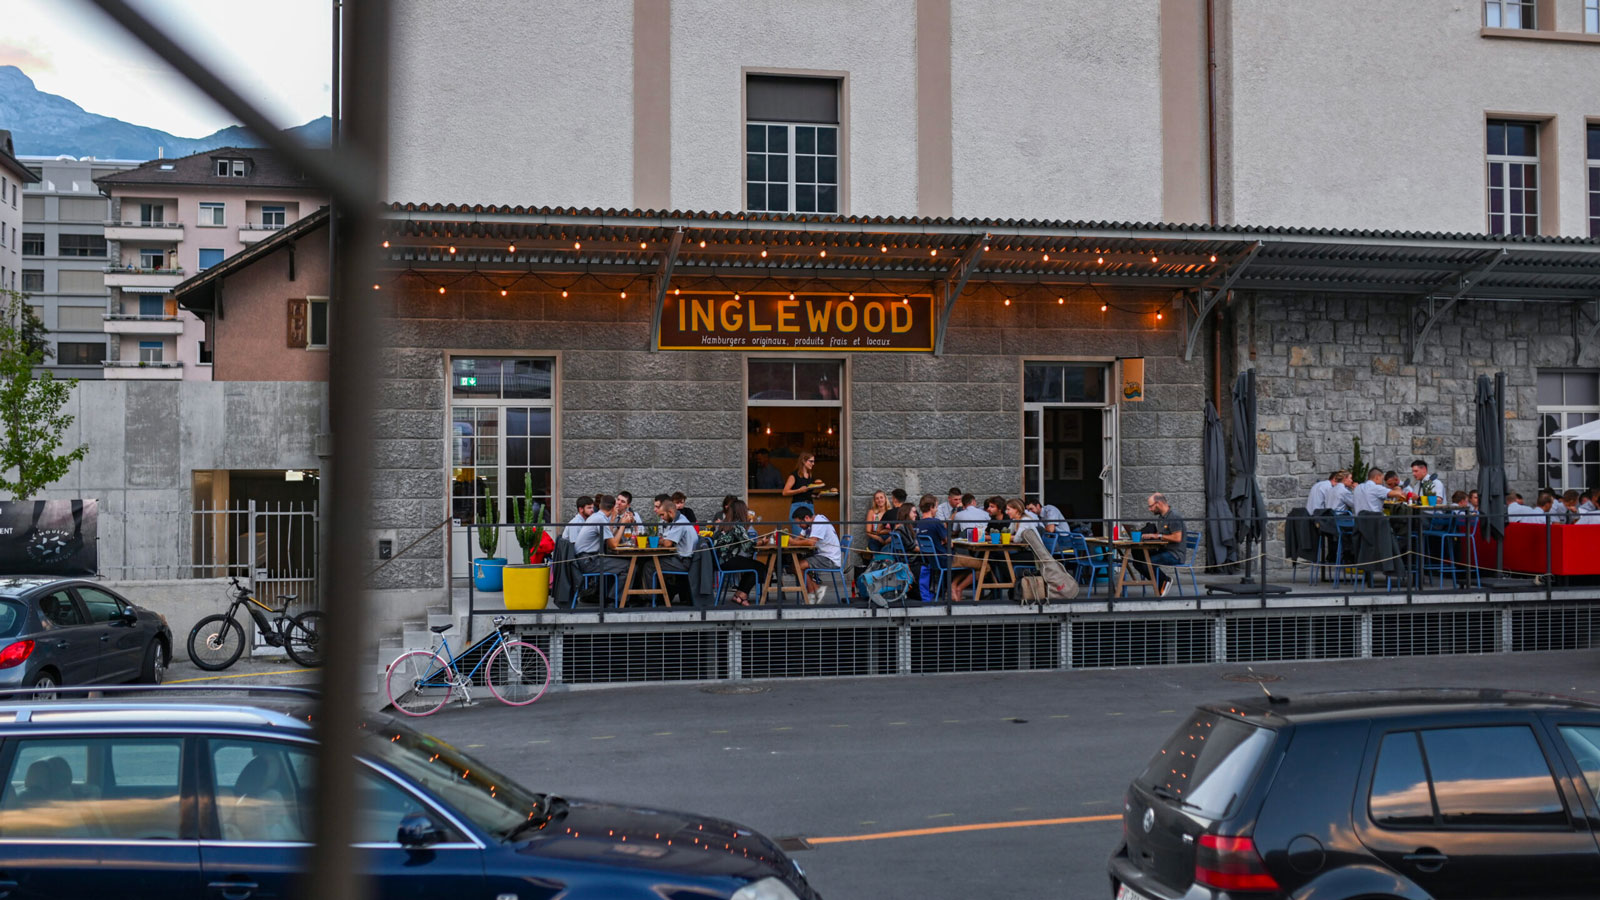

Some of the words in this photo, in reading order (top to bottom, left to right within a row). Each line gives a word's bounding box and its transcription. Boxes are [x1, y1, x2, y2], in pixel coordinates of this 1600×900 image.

[678, 299, 913, 333] INGLEWOOD
[701, 335, 746, 347] Hamburgers
[752, 336, 790, 347] originaux,
[794, 336, 824, 347] produits
[829, 336, 848, 347] frais
[853, 336, 861, 345] et
[866, 336, 891, 346] locaux
